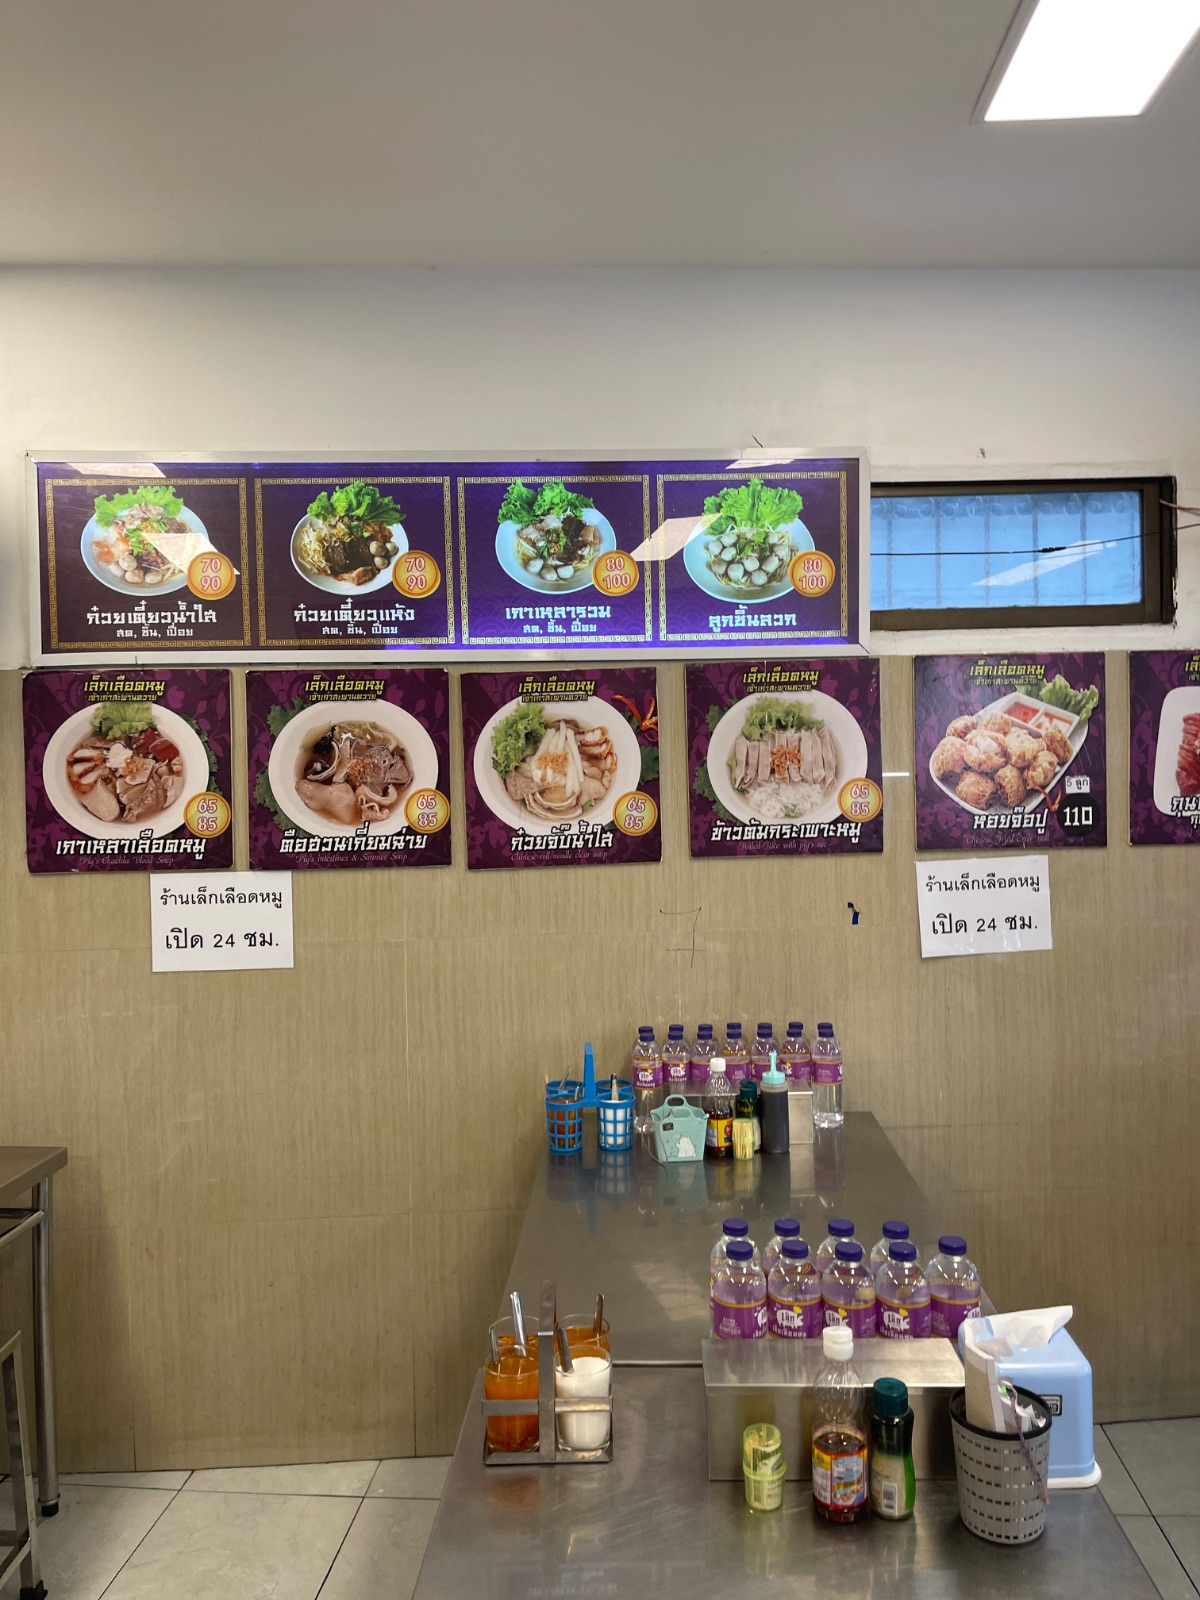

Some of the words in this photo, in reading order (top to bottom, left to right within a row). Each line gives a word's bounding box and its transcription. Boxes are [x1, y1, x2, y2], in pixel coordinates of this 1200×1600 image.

[200, 557, 221, 573] 70
[405, 556, 425, 573] 70
[606, 556, 625, 572] 80
[803, 557, 822, 573] 80
[200, 575, 221, 591] 90
[405, 574, 427, 591] 90
[603, 572, 631, 590] 100
[798, 574, 827, 590] 100
[86, 599, 217, 625] ก๋วยเตี๋ยวน้ำใส
[293, 597, 415, 623] ก๋วยเตี๋ยวแห้ง
[505, 606, 611, 619] เกาเหลารวม
[708, 604, 797, 633] ลูกชิ้นลวก
[166, 622, 194, 637] เปื่อย
[371, 619, 398, 634] เปื่อย
[742, 666, 819, 686] เล็กเลือดหมู
[969, 659, 1045, 679] เล็กเลือดหมู
[83, 675, 166, 696] เล็กเลือดหมู
[305, 674, 385, 695] เล็กเลือดหมู
[518, 675, 596, 696] เล็กเลือดหมู
[851, 784, 870, 798] 65
[1066, 779, 1073, 787] 5
[1075, 779, 1089, 790] ลูก
[197, 798, 217, 813] 65
[416, 795, 437, 810] 65
[626, 797, 646, 813] 65
[850, 801, 870, 816] 85
[197, 816, 217, 832] 85
[417, 812, 437, 827] 85
[624, 814, 645, 831] 85
[973, 806, 1049, 834] หอยจ๊อปู
[1063, 806, 1093, 826] 110
[510, 820, 613, 851] ก๋วยจั๊บน้ำใส
[710, 818, 862, 844] ข้าวต้มกระเพาะหมู
[56, 829, 207, 860] เกาเหลาเลือดหมู
[132, 855, 153, 865] Blood
[155, 855, 174, 867] Soup
[351, 854, 358, 862] &
[390, 853, 408, 864] Soup
[593, 851, 608, 861] soup
[925, 872, 1040, 893] ร้านเล็กเลือดหมู
[160, 885, 283, 909] ร้านเล็กเลือดหมู
[932, 912, 968, 935] เปิด
[976, 917, 997, 932] 24
[1004, 914, 1038, 931] ชม.
[165, 926, 204, 949] เปิด
[213, 933, 236, 948] 24
[243, 931, 279, 947] ชม.
